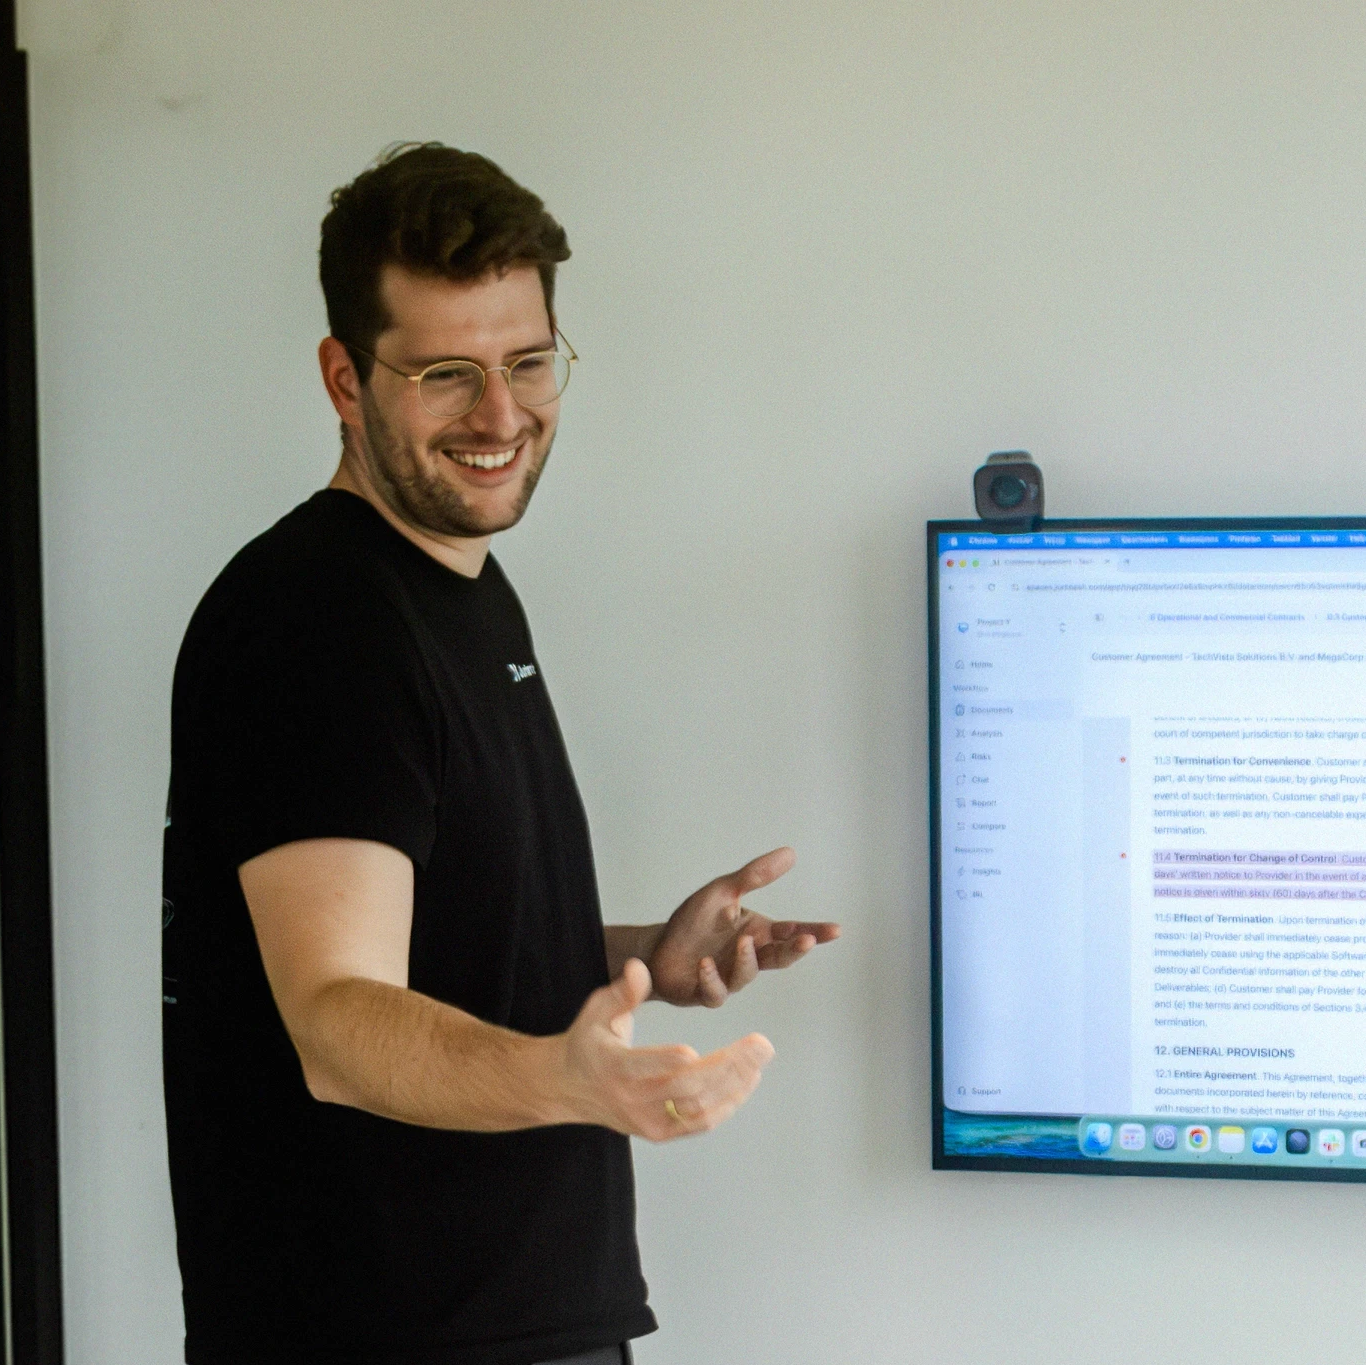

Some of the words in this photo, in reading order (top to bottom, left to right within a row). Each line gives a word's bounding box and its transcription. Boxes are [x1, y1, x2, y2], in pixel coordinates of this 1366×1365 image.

[971, 706, 1014, 714] Documents
[1173, 756, 1231, 765] Termination
[1232, 756, 1247, 765] for
[1316, 757, 1362, 766] Customer
[1222, 809, 1240, 818] well
[1255, 811, 1272, 820] any
[1273, 810, 1344, 819] non-cancelable
[1173, 852, 1231, 862] Termination
[1232, 853, 1247, 862] for
[1249, 853, 1286, 865] Change
[1173, 913, 1202, 922] Effect
[1278, 915, 1304, 926] Upon
[1305, 915, 1357, 925] termination
[1204, 932, 1242, 941] Provider
[1244, 933, 1265, 941] shall
[1267, 933, 1322, 944] immediately
[1154, 948, 1209, 959] immediately
[1239, 949, 1265, 961] using
[1266, 950, 1281, 959] the
[1283, 950, 1330, 962] applicable
[1172, 1046, 1224, 1057] GENERAL
[1226, 1047, 1296, 1058] PROVISIONS
[1173, 1069, 1202, 1079] Entire
[1261, 1072, 1281, 1081] This
[971, 1088, 1002, 1096] Support
